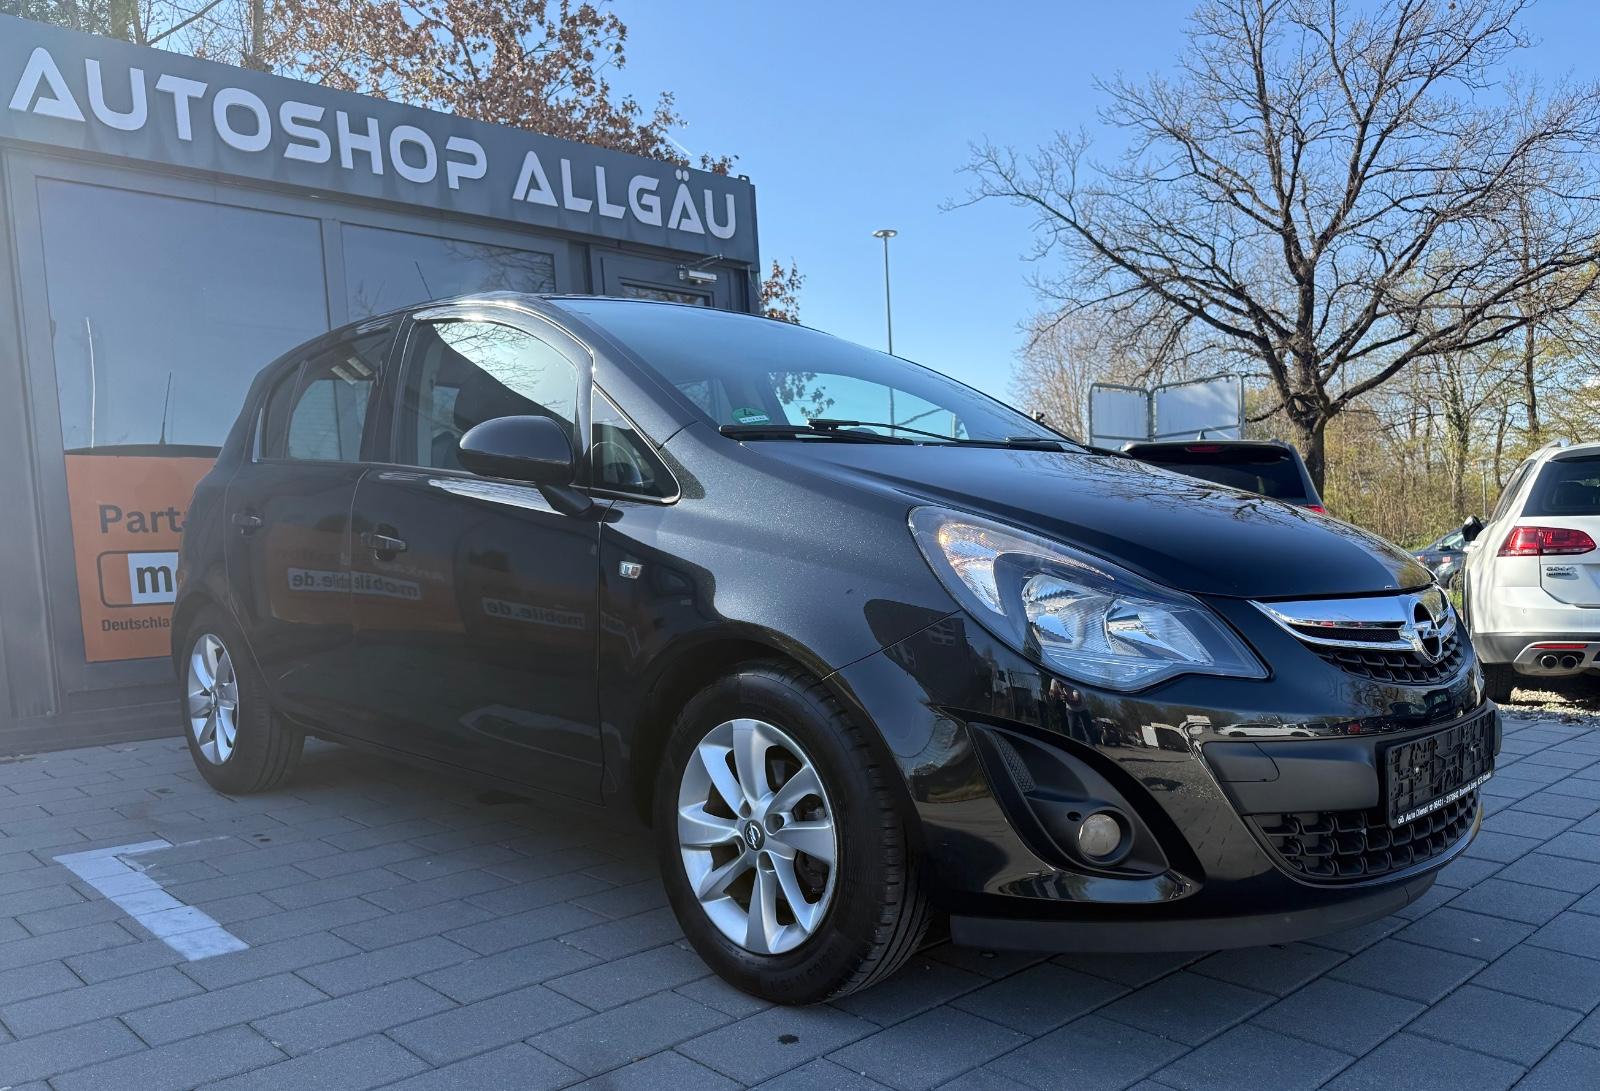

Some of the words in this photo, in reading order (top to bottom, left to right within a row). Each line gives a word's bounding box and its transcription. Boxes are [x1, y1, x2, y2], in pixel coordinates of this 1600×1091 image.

[9, 46, 487, 190] AUTOSHOP
[512, 149, 736, 240] ALLGÄU
[99, 503, 186, 533] Part
